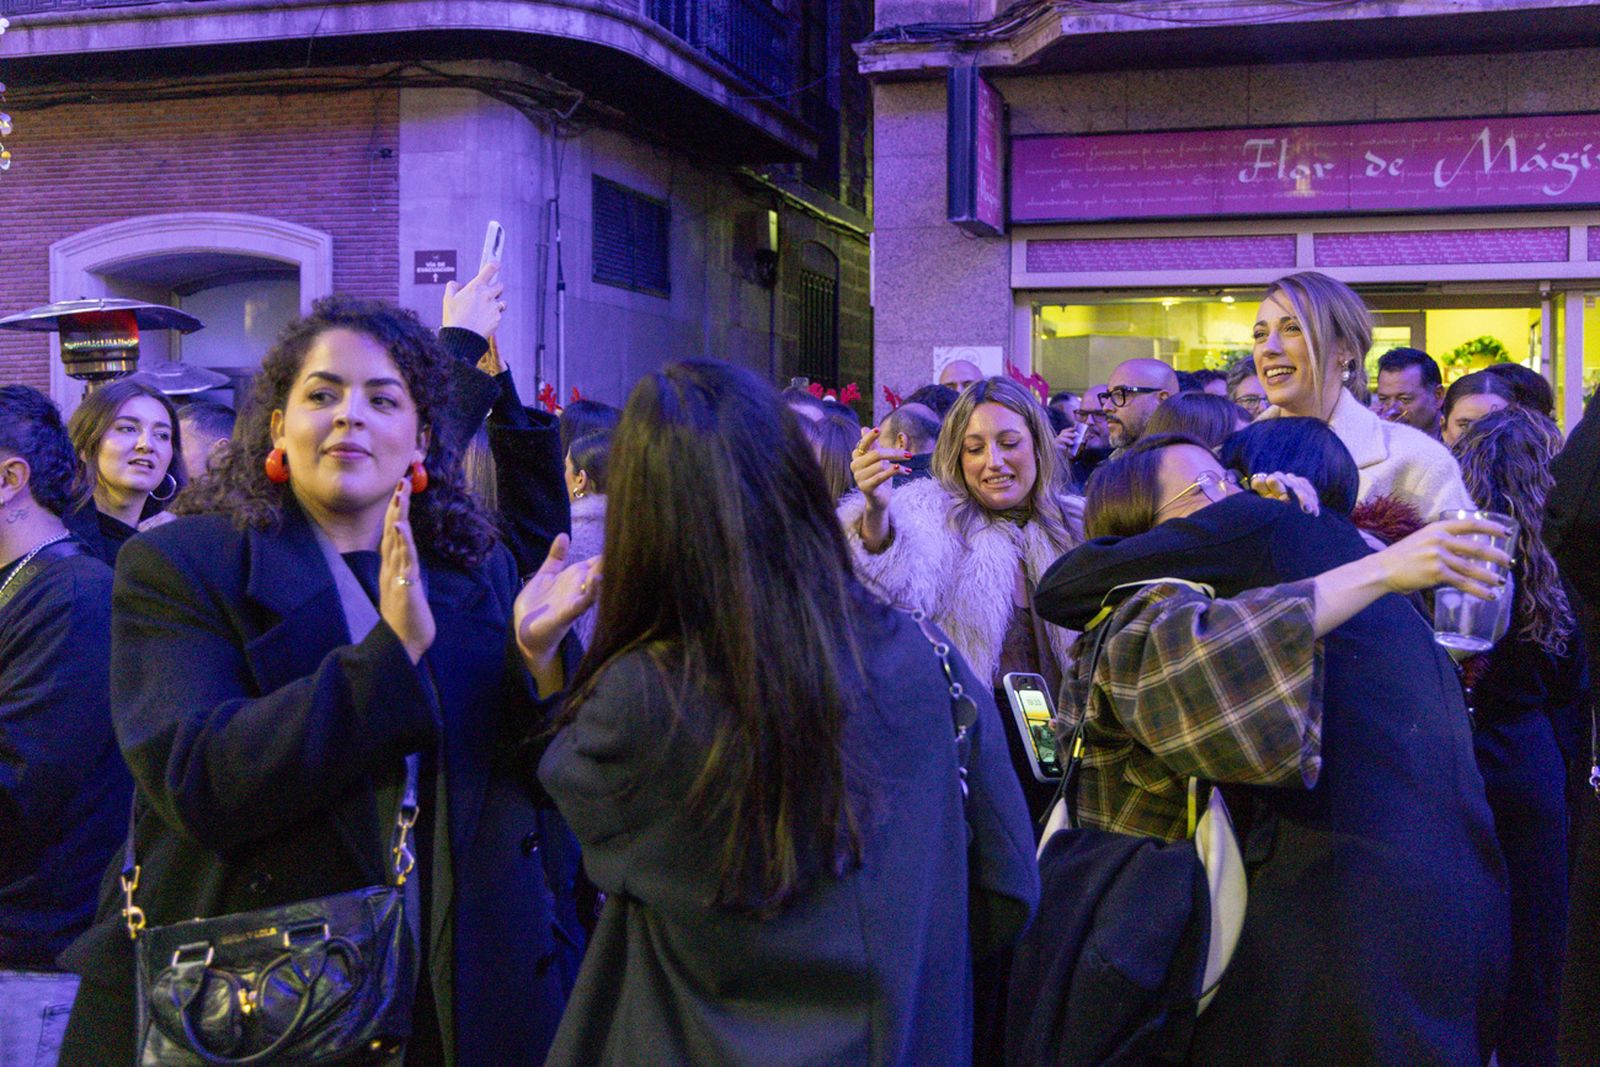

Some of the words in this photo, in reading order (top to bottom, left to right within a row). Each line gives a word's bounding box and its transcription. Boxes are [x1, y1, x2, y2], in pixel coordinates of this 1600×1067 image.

[1238, 138, 1335, 183] Flor
[1364, 150, 1405, 177] de
[1433, 126, 1600, 196] Mági
